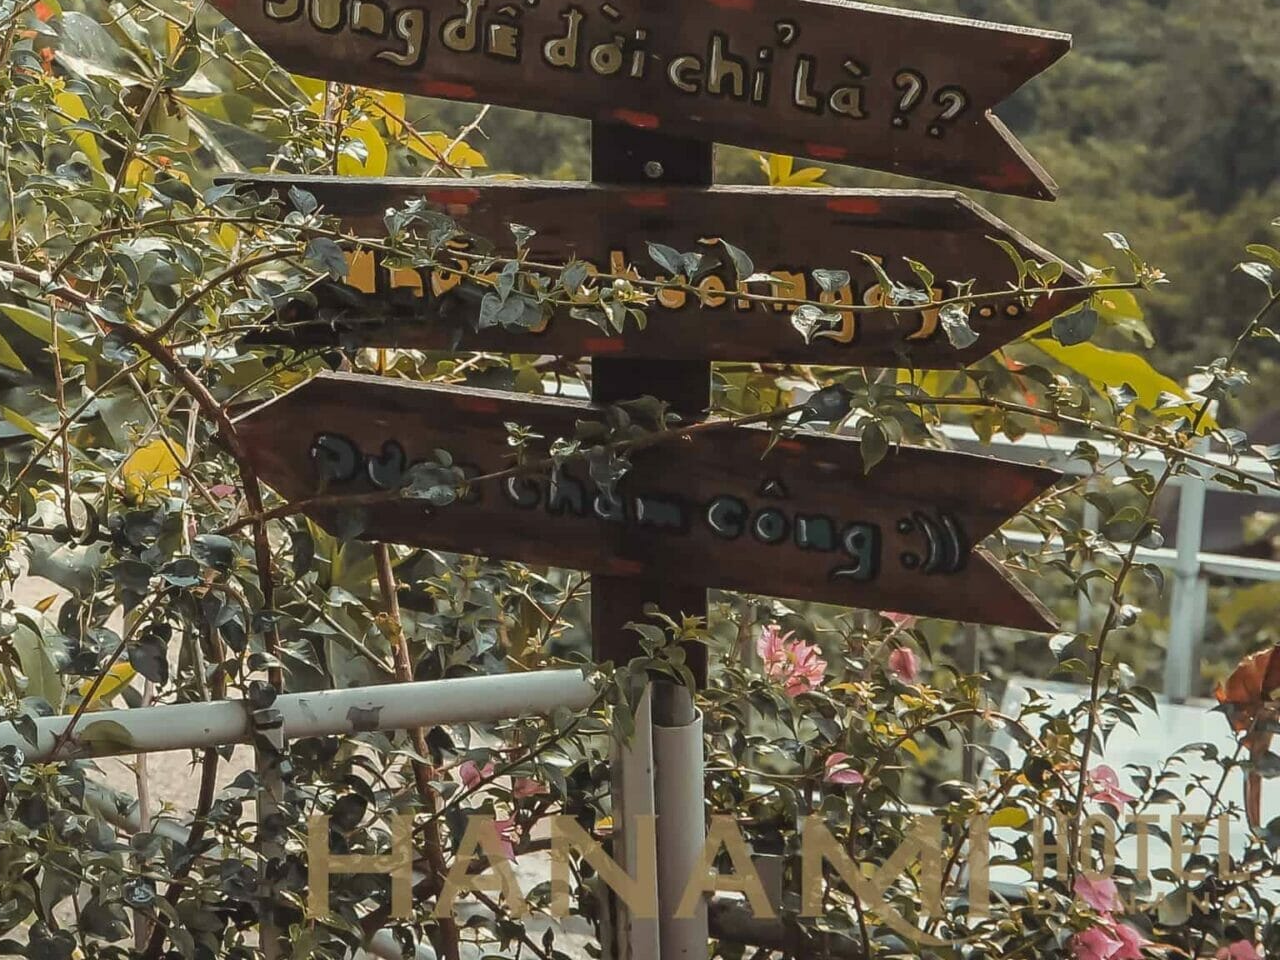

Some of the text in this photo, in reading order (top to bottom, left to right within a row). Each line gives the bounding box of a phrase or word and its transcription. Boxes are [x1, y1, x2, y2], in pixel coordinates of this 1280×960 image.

[541, 3, 648, 80] đời
[665, 20, 801, 105] chỉ
[706, 478, 882, 583] công
